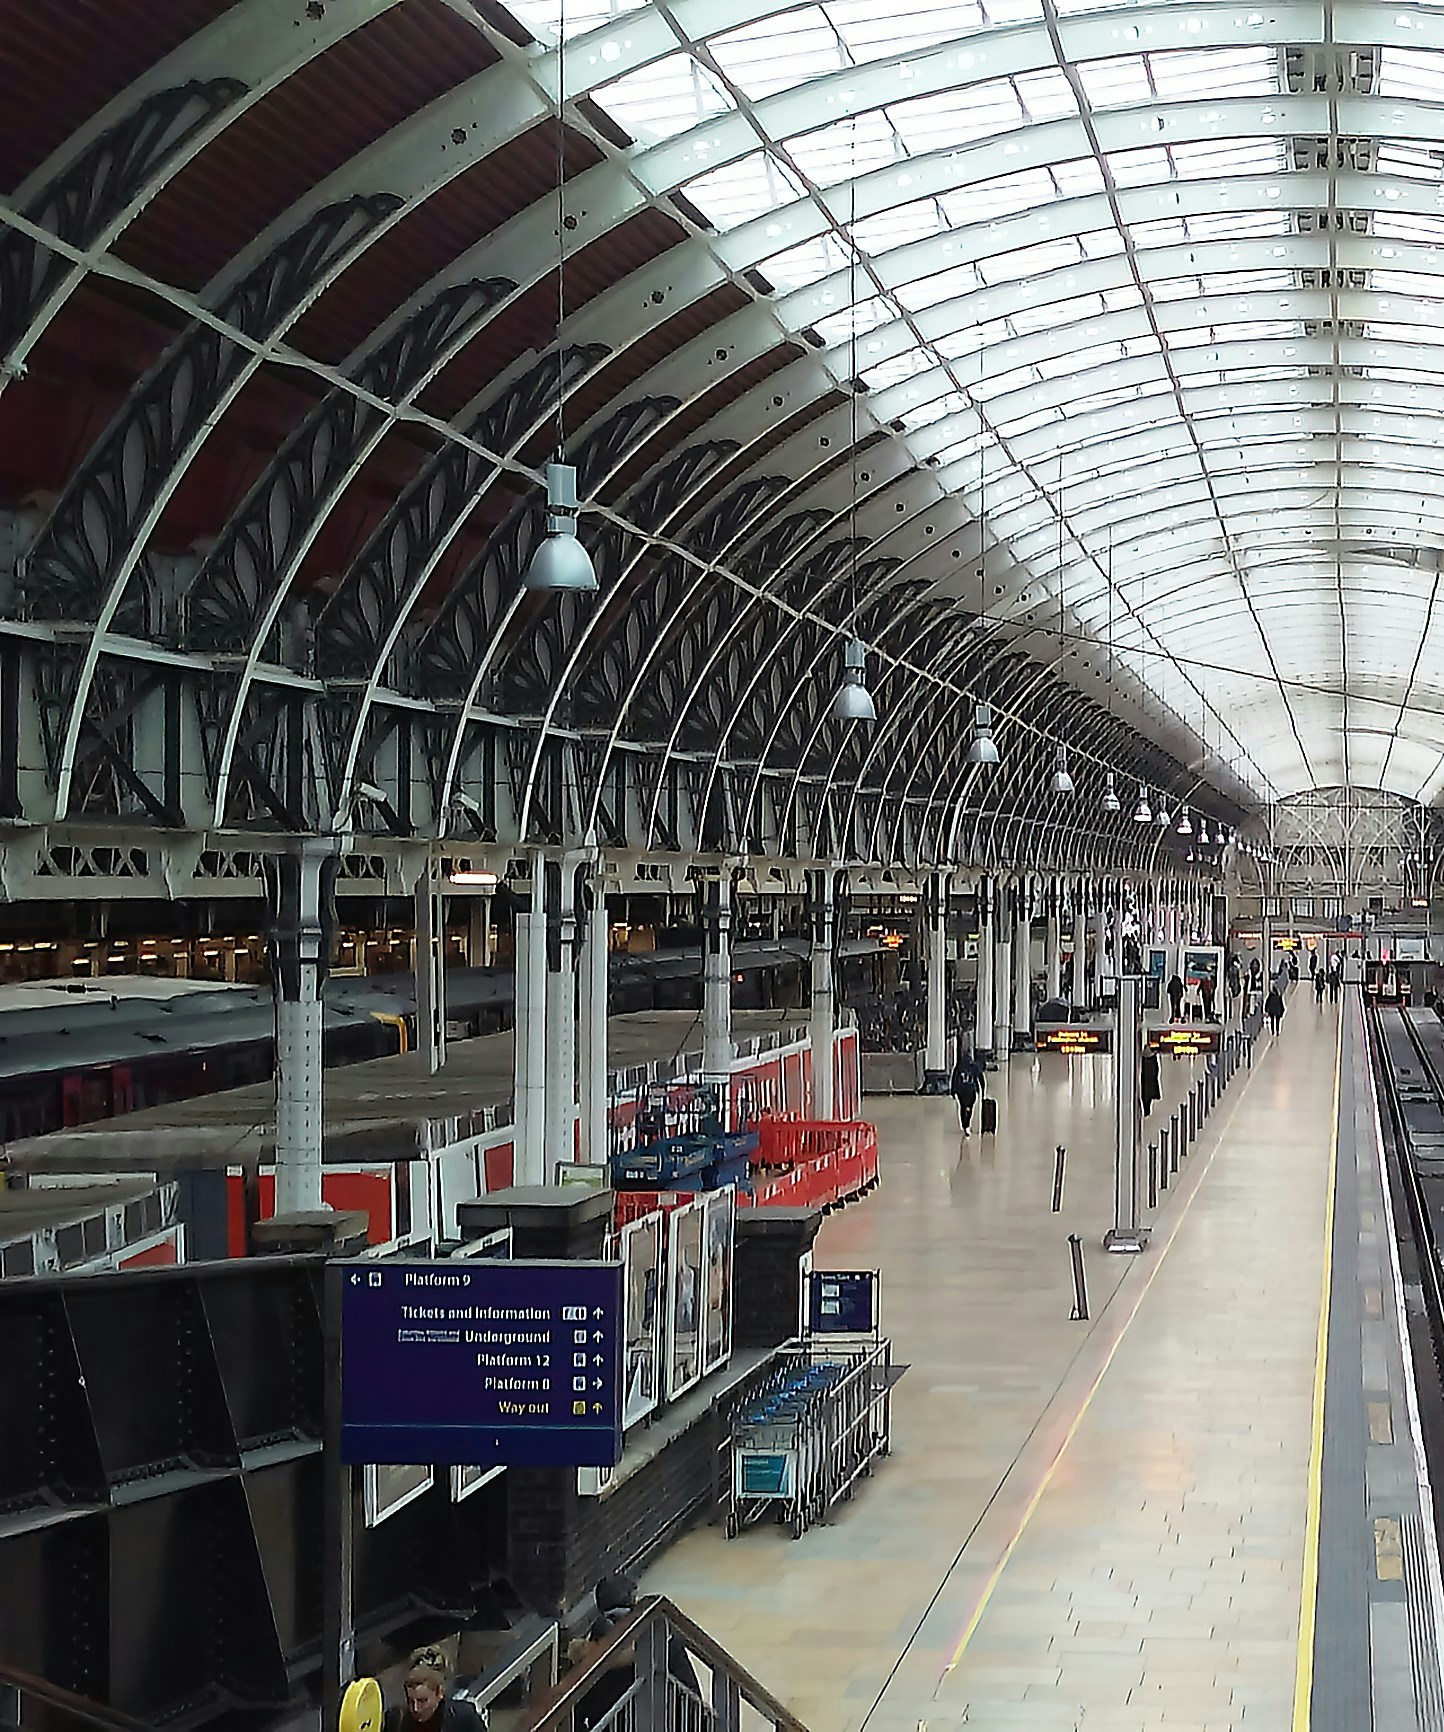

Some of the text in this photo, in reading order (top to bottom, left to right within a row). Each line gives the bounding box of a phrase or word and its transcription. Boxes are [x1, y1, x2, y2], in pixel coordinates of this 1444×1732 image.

[405, 1272, 471, 1287] Platform 9
[400, 1305, 551, 1321] Tickets and Information
[465, 1330, 551, 1346] Underground
[477, 1353, 550, 1367] Platform 12
[484, 1376, 539, 1391] Platform
[498, 1401, 549, 1416] Way out
